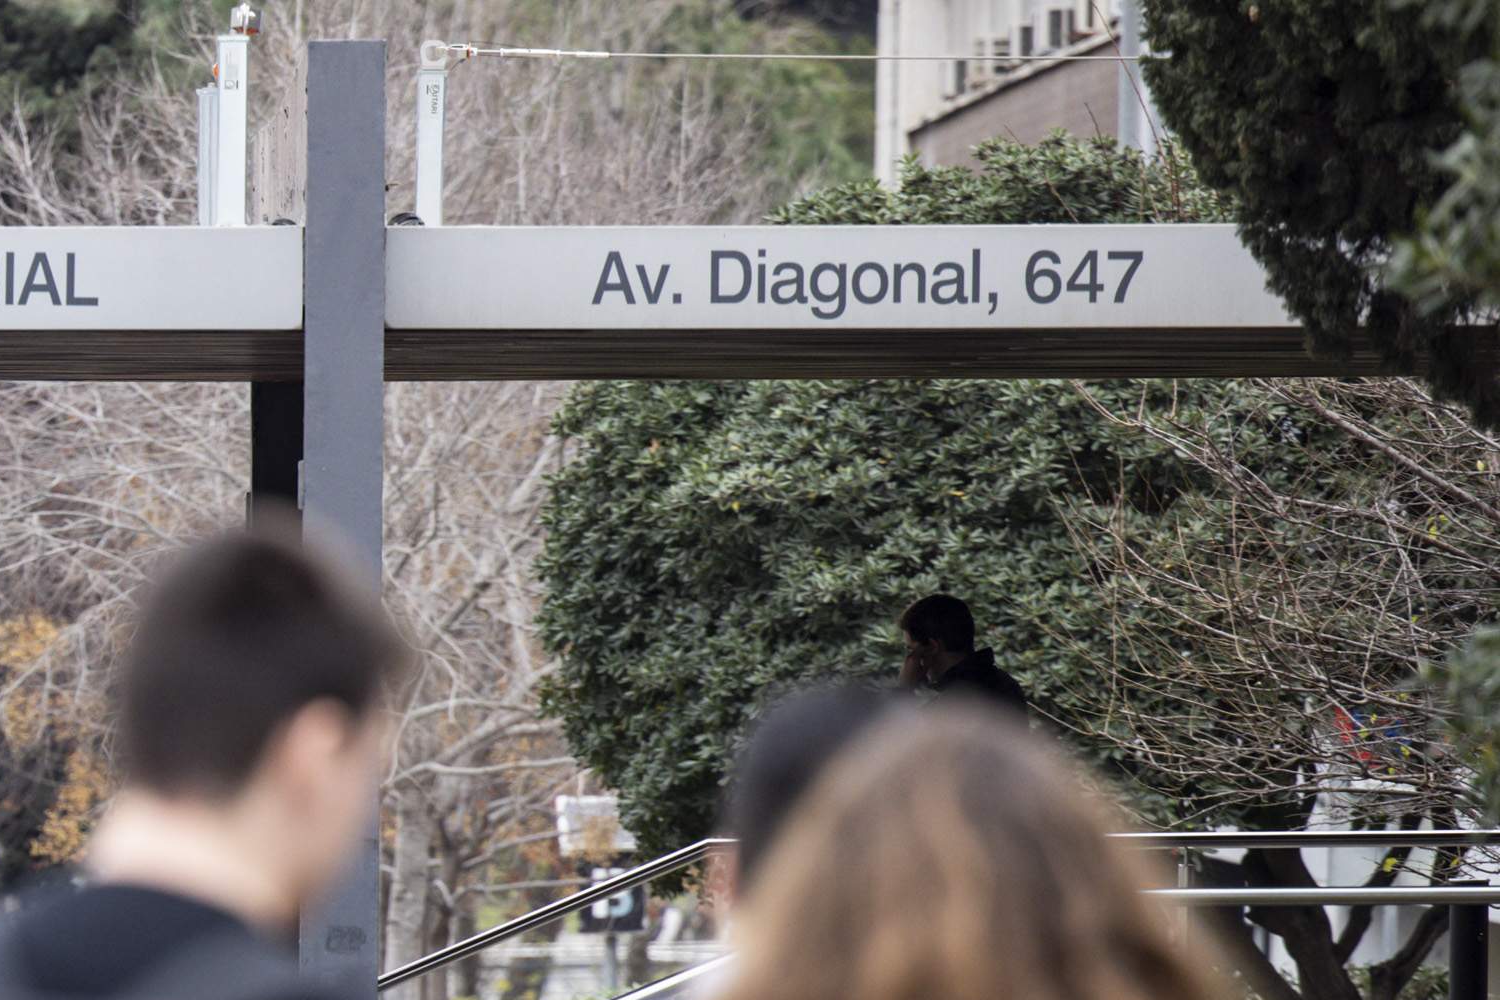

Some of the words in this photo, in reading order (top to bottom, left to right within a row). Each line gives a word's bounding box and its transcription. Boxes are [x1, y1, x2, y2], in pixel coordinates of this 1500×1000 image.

[592, 249, 682, 305] Av.
[710, 248, 998, 320] Diagonal,
[1024, 249, 1144, 305] 647
